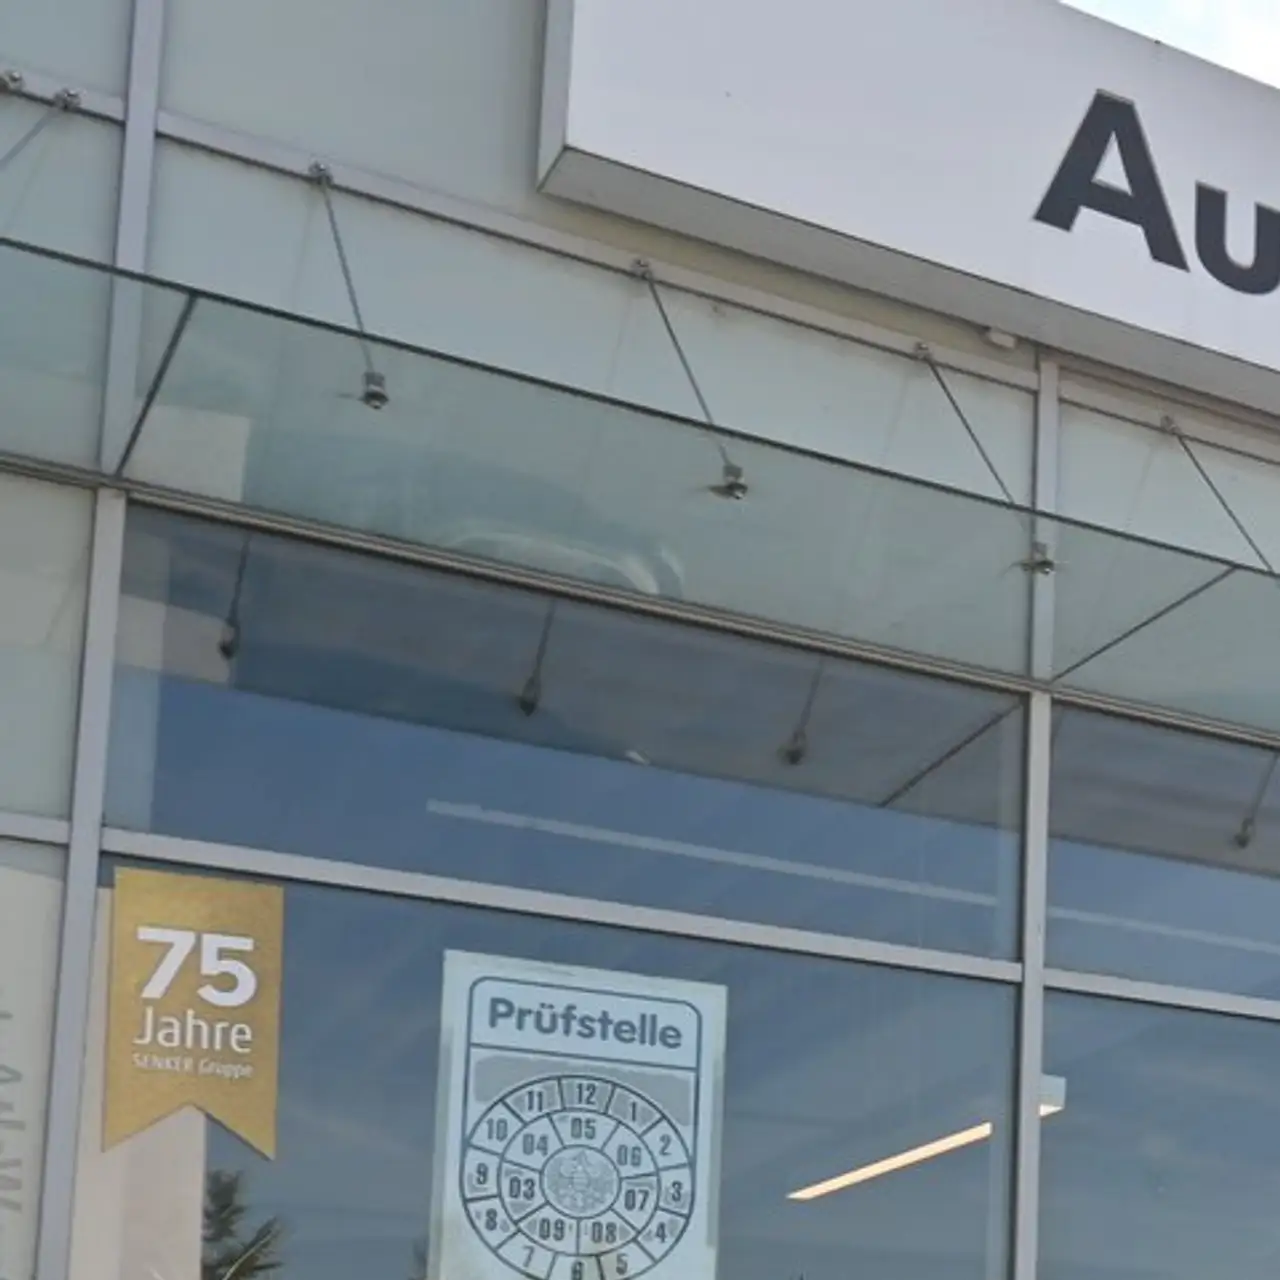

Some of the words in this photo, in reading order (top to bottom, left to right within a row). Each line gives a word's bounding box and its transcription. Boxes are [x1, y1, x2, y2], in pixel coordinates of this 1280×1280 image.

[136, 925, 258, 1007] 75
[131, 1006, 253, 1054] Jahre
[488, 996, 683, 1049] Prüfstelle
[527, 1091, 543, 1112] 11
[577, 1084, 596, 1104] 12
[629, 1102, 637, 1122] 1
[486, 1119, 508, 1141] 10
[570, 1117, 597, 1140] 05
[522, 1134, 548, 1156] 04
[617, 1145, 641, 1167] 06
[659, 1135, 671, 1156] 2
[476, 1163, 488, 1185] 9
[509, 1179, 535, 1200] 03
[624, 1189, 649, 1211] 07
[671, 1181, 683, 1202] 3
[485, 1209, 498, 1231] 8
[539, 1219, 565, 1240] 09
[591, 1222, 617, 1243] 08
[655, 1222, 667, 1243] 4
[523, 1246, 535, 1268] 7
[615, 1253, 628, 1275] 5
